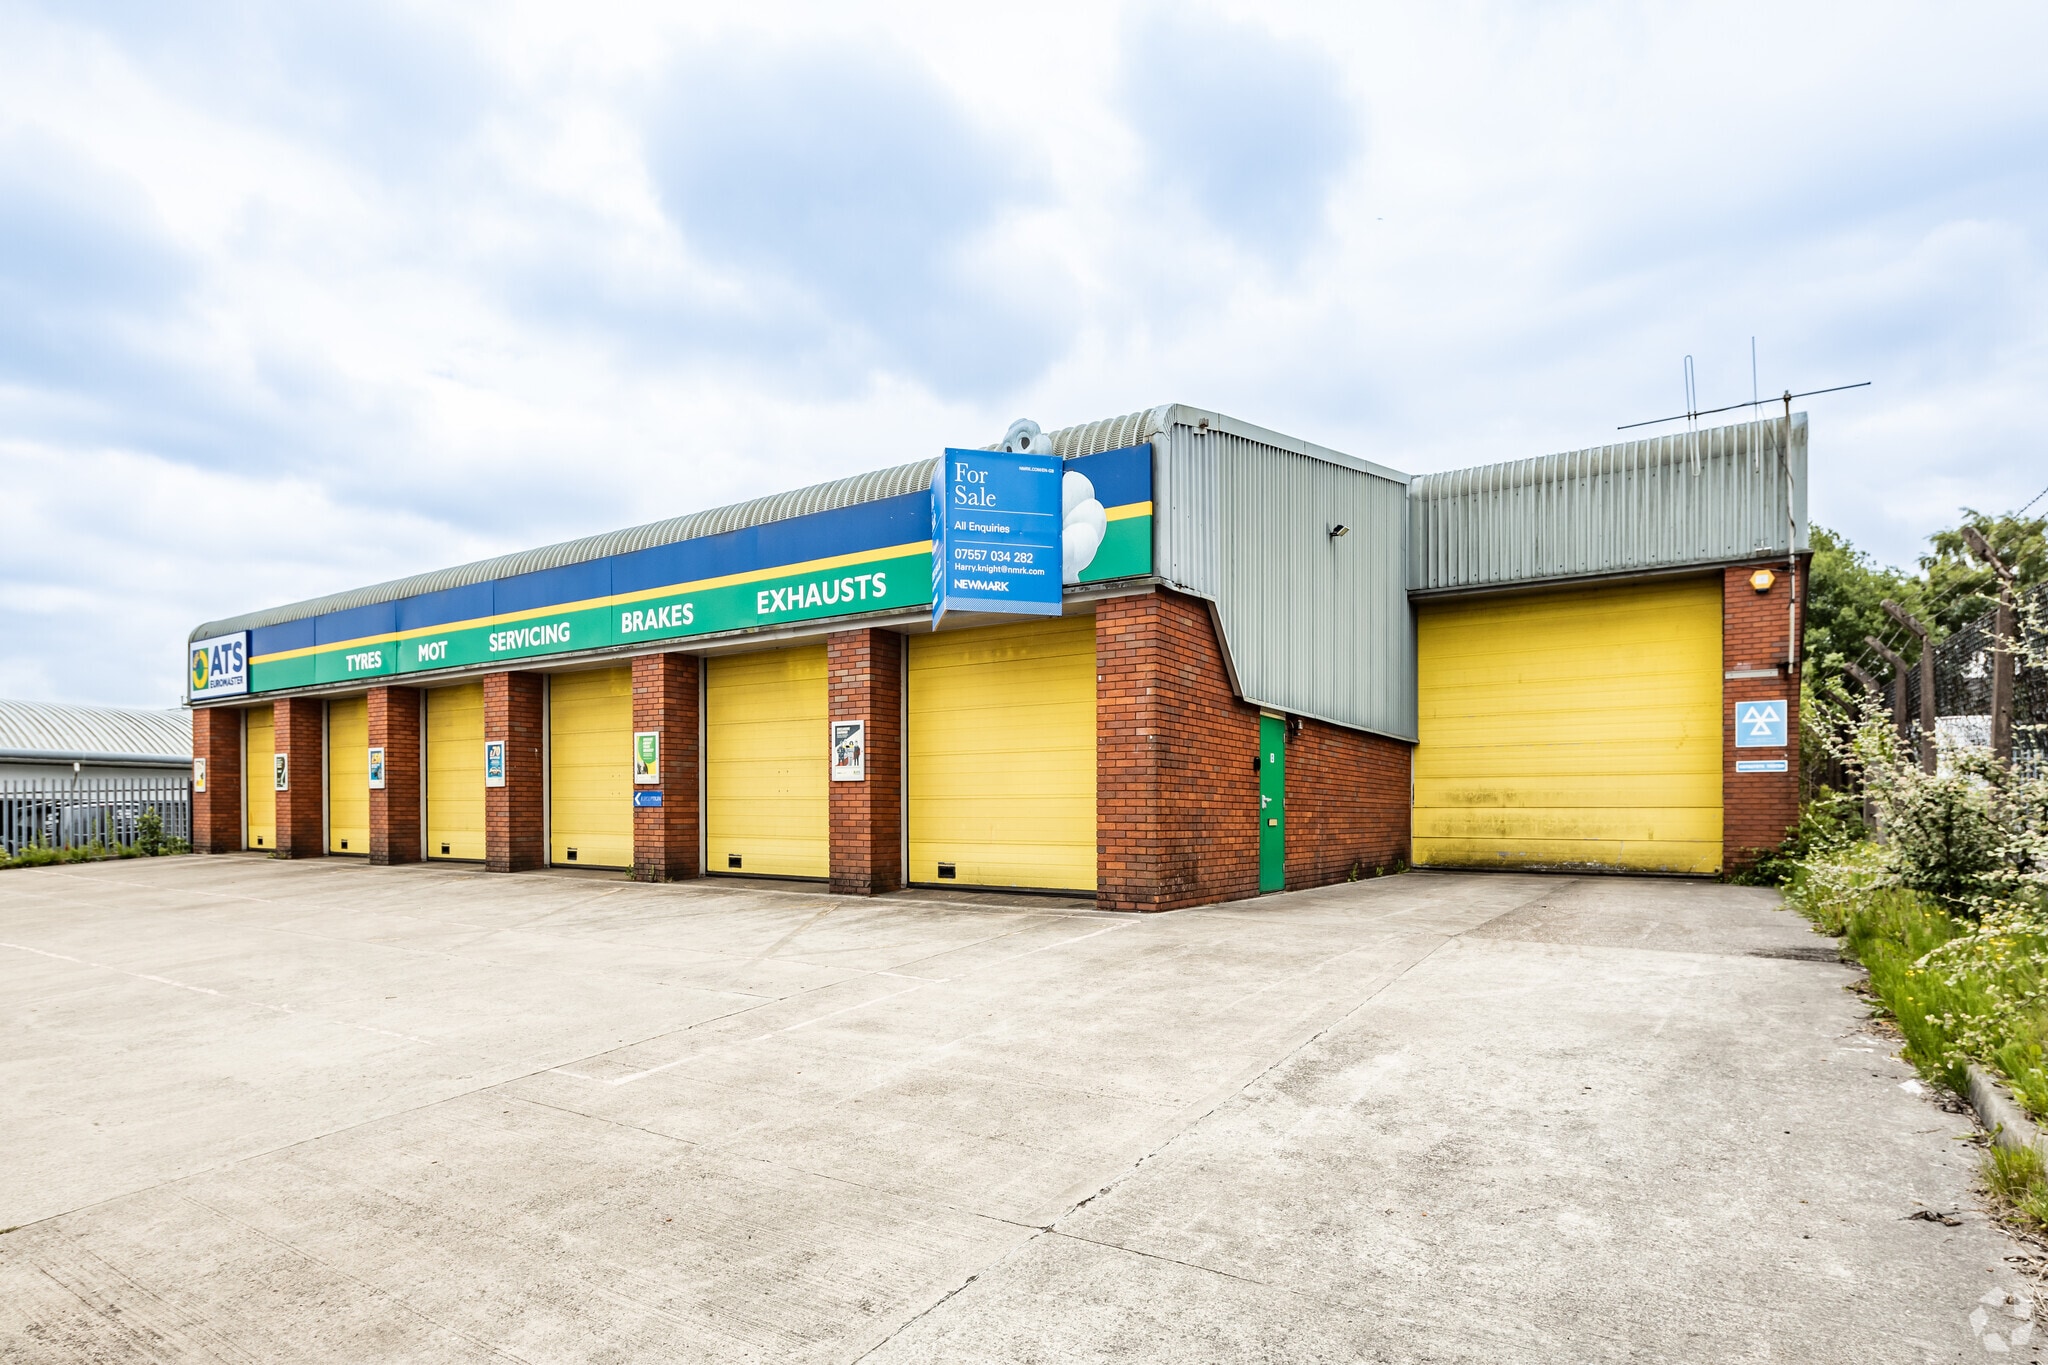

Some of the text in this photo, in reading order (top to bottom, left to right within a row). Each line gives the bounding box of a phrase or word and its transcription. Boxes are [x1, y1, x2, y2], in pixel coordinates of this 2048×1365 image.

[954, 462, 989, 484] For
[954, 484, 996, 507] Sale
[954, 520, 1010, 534] All Enquiries
[954, 548, 1033, 564] 07557 034 282
[954, 562, 1045, 576] Harry.knight@nmrk.com
[757, 572, 888, 615] EXHAUSTS
[954, 578, 1009, 592] NEWMARK
[621, 602, 694, 634] BRAKES
[489, 621, 571, 652] SERVICING
[210, 641, 243, 676] ATS
[346, 650, 382, 672] TYRES
[418, 640, 448, 662] MOT
[210, 675, 244, 689] EUROMASTER
